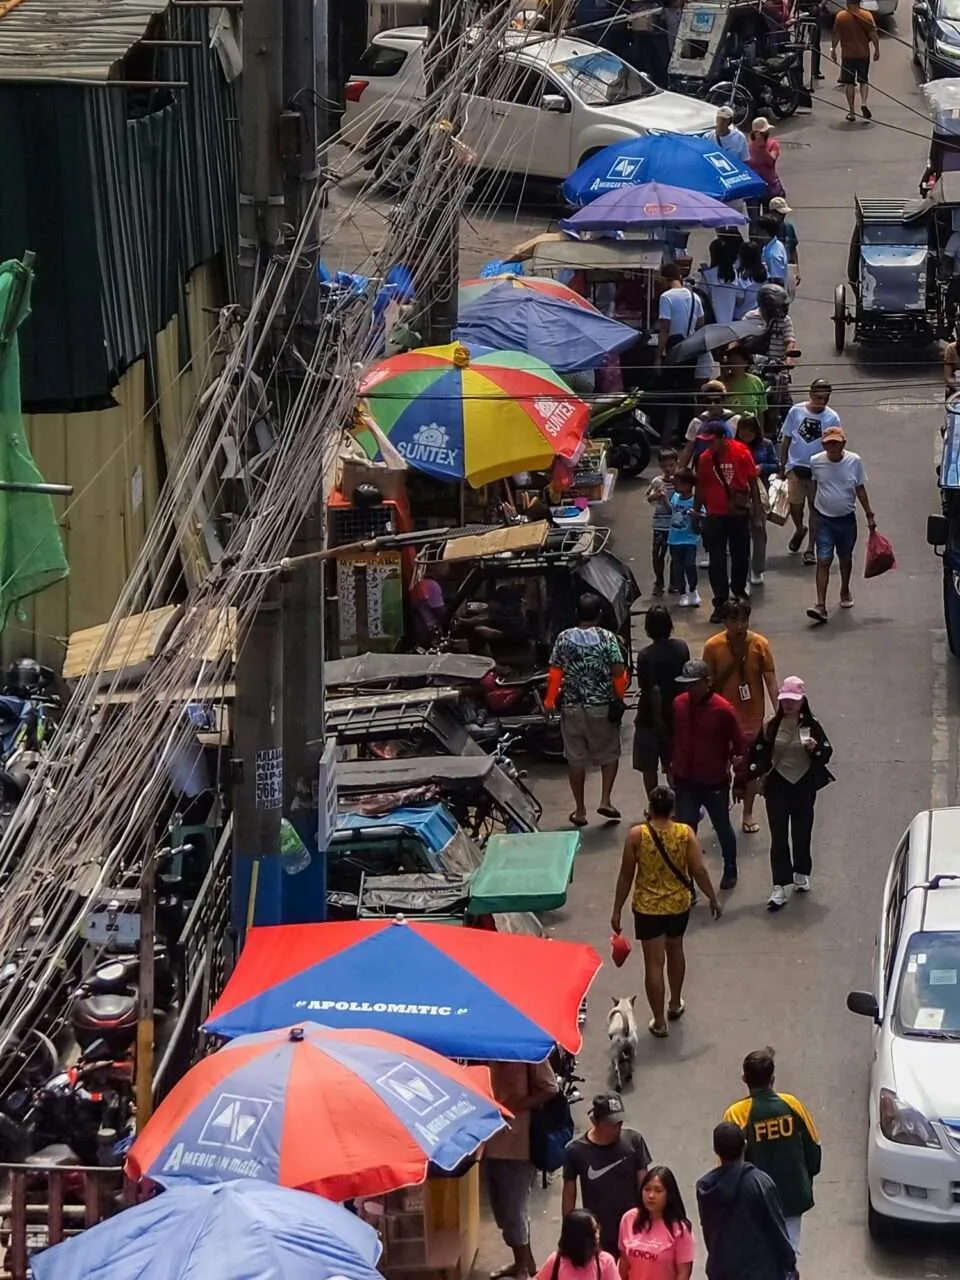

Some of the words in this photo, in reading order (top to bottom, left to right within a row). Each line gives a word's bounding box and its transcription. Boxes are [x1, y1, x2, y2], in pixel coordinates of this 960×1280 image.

[544, 399, 577, 437] SUNTEX
[397, 441, 459, 466] SUNTEX
[754, 1114, 794, 1142] FEU
